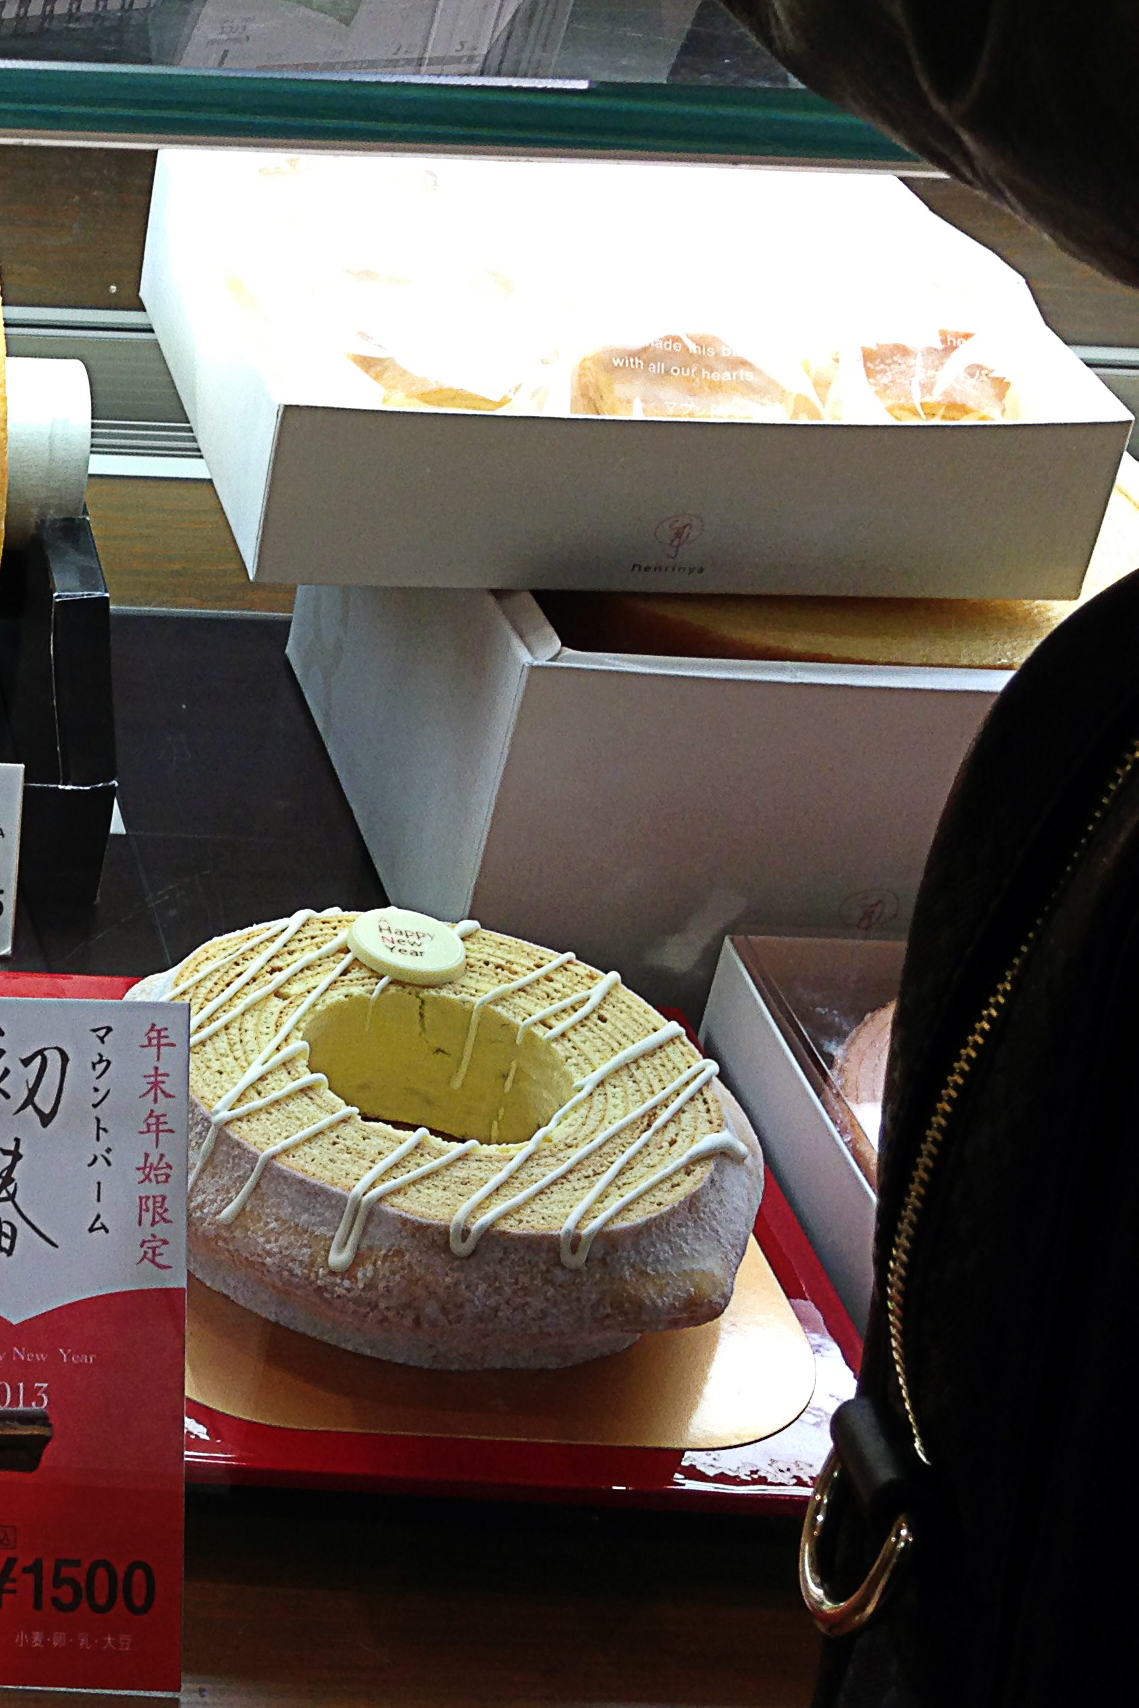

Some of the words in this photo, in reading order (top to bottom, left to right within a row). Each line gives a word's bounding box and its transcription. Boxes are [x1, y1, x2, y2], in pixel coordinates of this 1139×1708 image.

[612, 356, 644, 370] with
[648, 362, 665, 375] all
[670, 366, 696, 377] our
[701, 368, 759, 382] hearts.
[378, 924, 436, 941] Happy
[381, 935, 422, 947] New
[383, 944, 425, 957] Year
[86, 1025, 114, 1235] マウントバーム
[135, 1022, 177, 1271] 年末年始限定
[13, 1346, 49, 1363] New
[58, 1348, 97, 1364] Year
